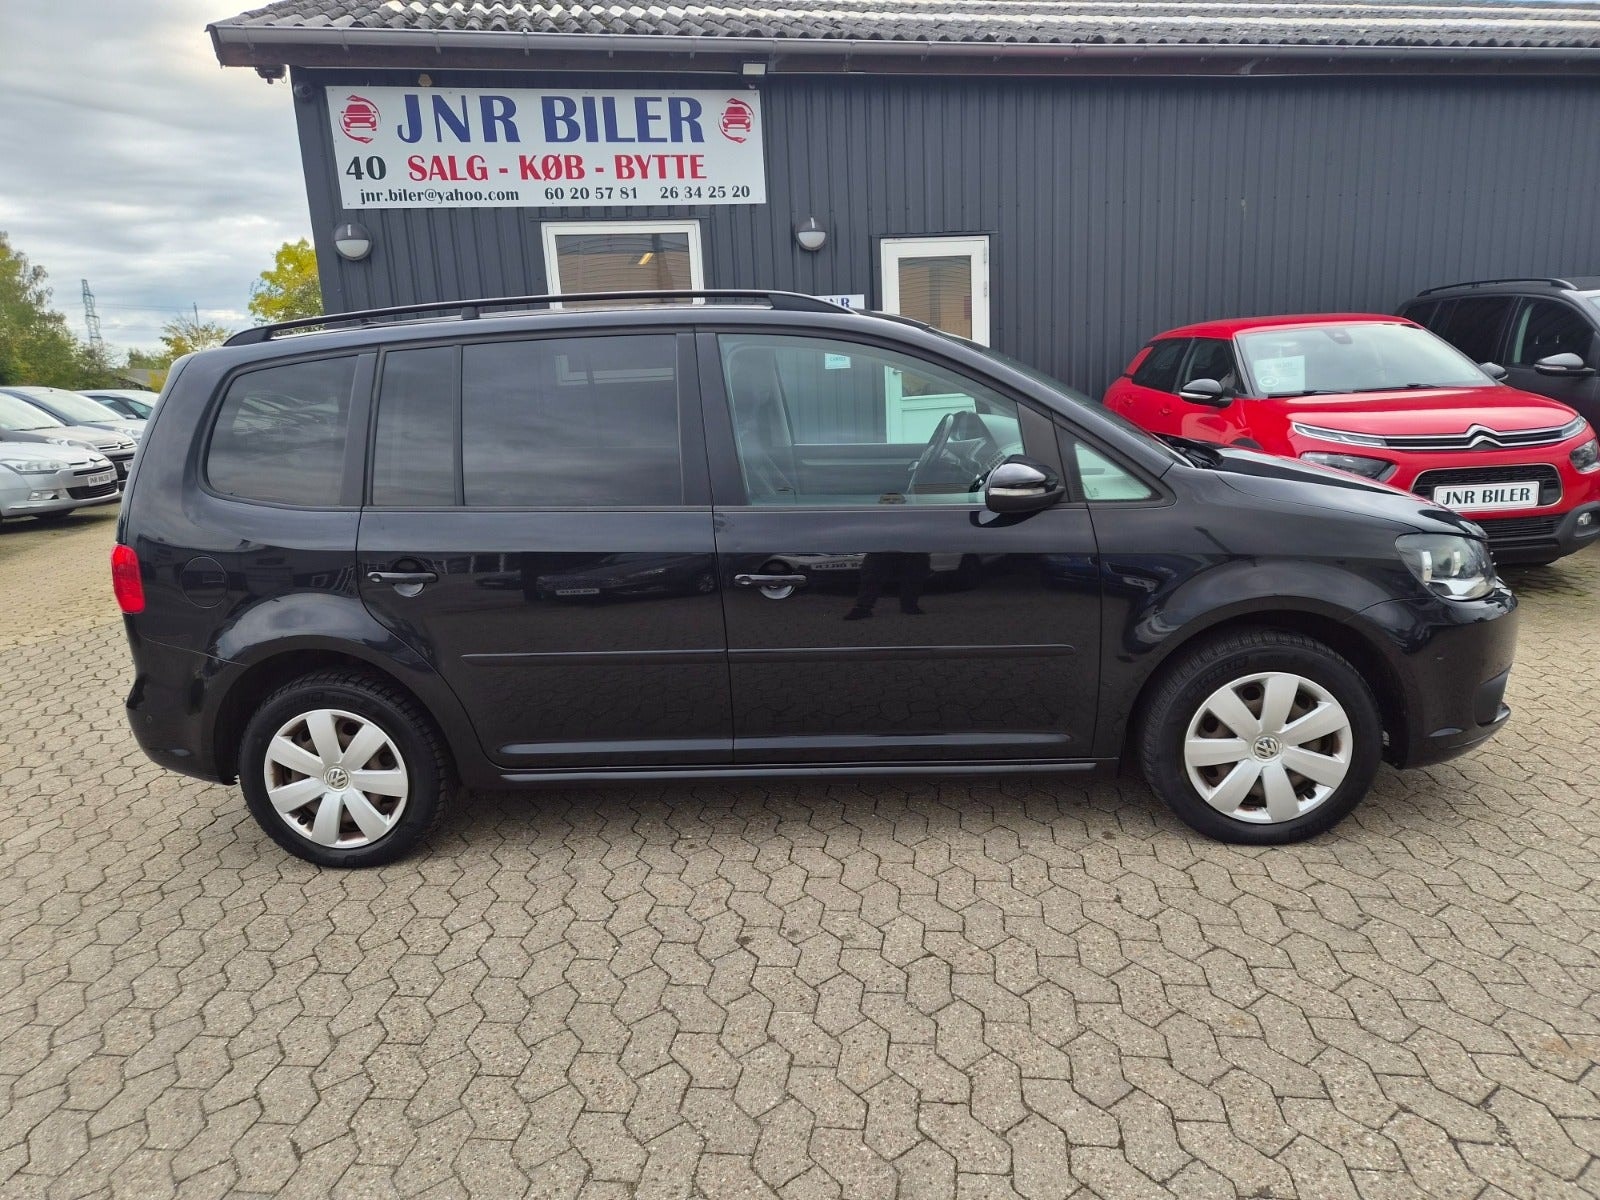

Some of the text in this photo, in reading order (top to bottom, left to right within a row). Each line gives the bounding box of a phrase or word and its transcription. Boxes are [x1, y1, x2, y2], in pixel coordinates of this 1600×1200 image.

[397, 94, 705, 143] JNR BILER
[345, 155, 387, 181] 40
[407, 154, 489, 182] SALG
[518, 153, 586, 182] KØB
[614, 154, 707, 180] BYTTE
[360, 188, 520, 205] jnr.biler@yahoo.com
[544, 187, 638, 200] 60 20 57 81
[659, 185, 750, 199] 26 34 25 20
[1442, 488, 1530, 505] JNR BILER
